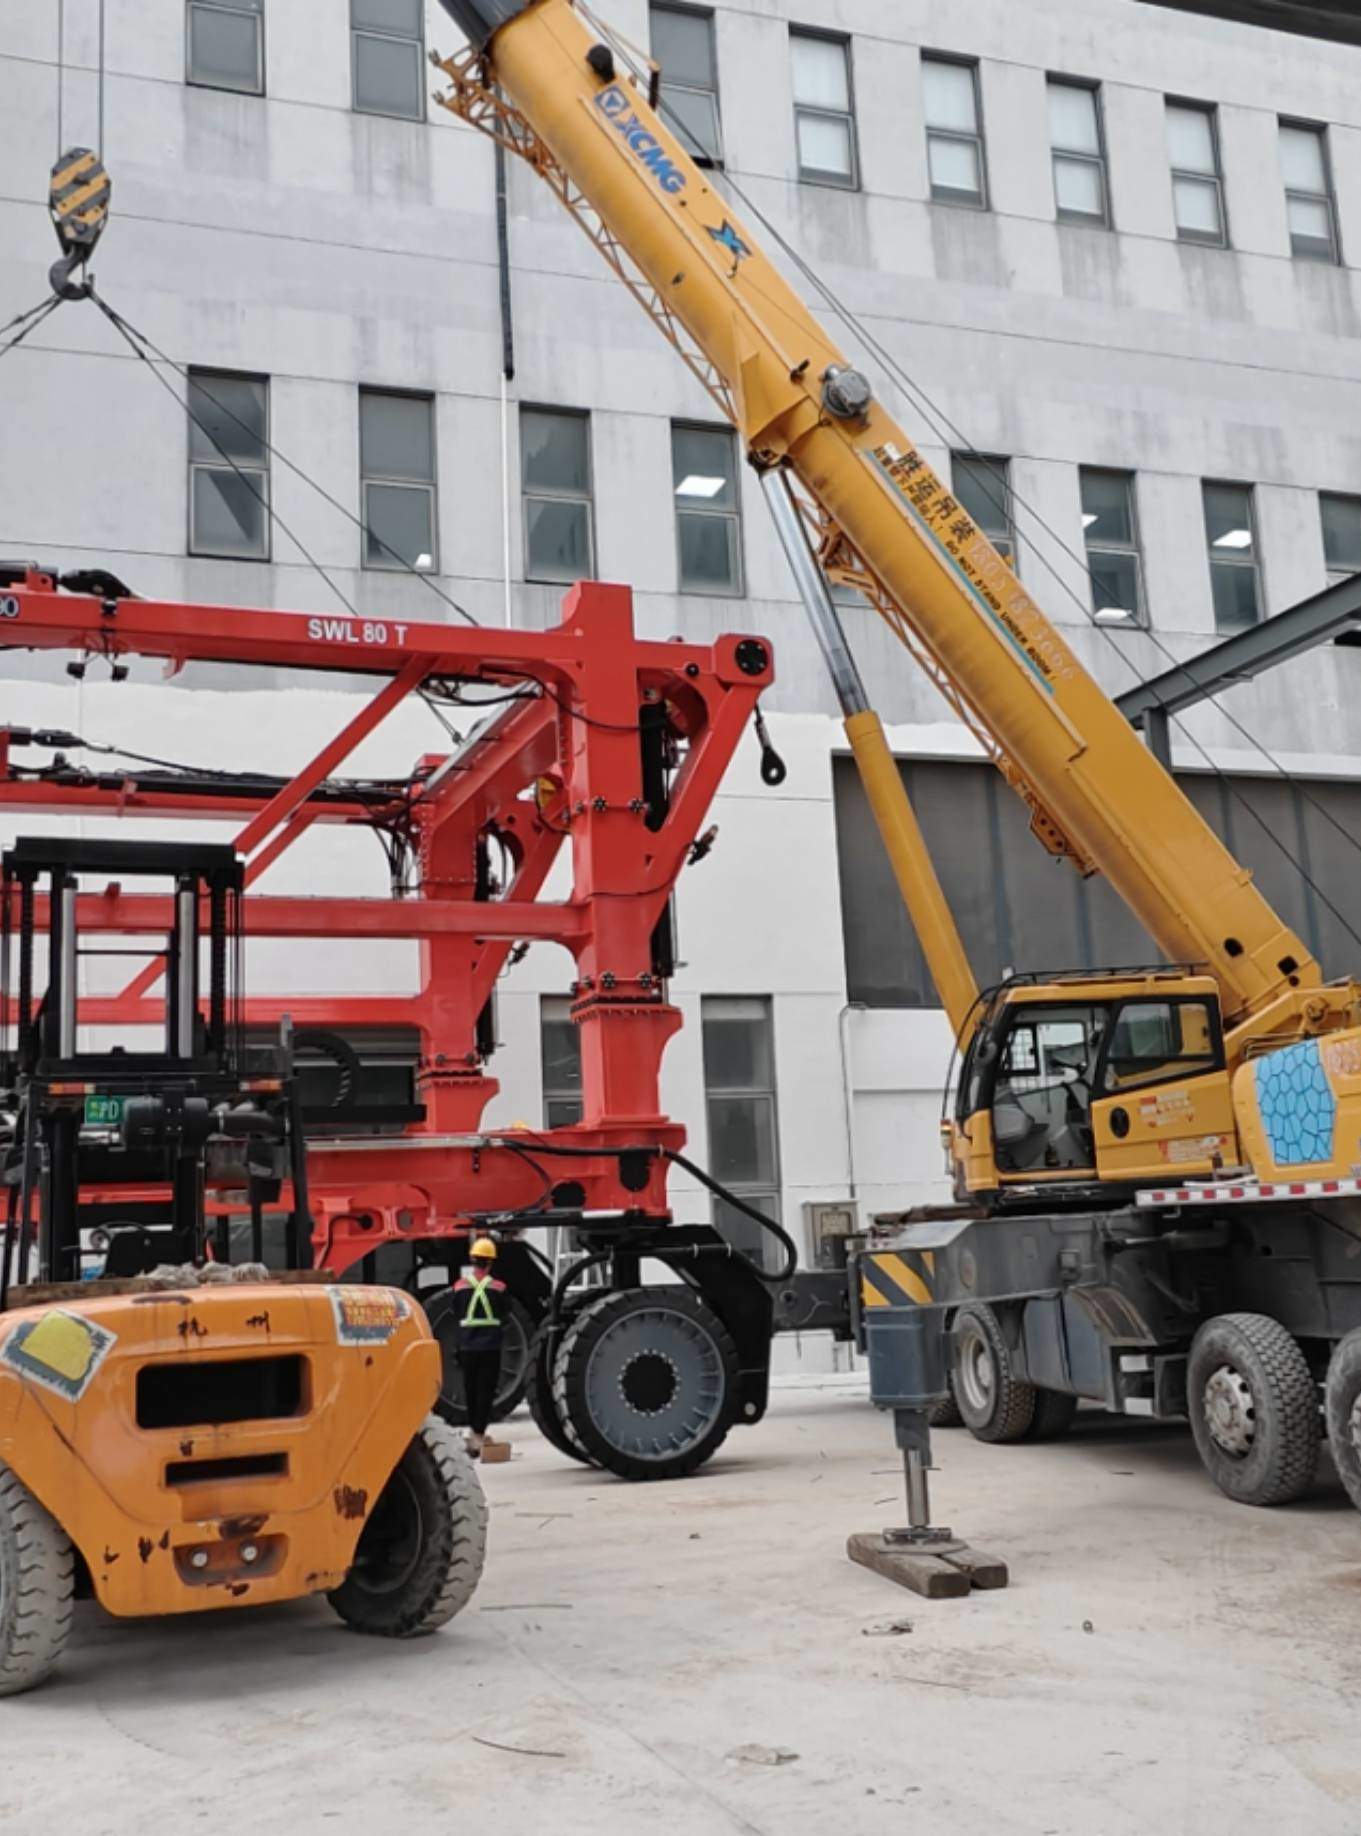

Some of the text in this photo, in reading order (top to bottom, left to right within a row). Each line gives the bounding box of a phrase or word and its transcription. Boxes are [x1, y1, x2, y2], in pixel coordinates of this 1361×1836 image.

[614, 113, 687, 194] XCMG
[308, 618, 408, 646] SWL 80 T
